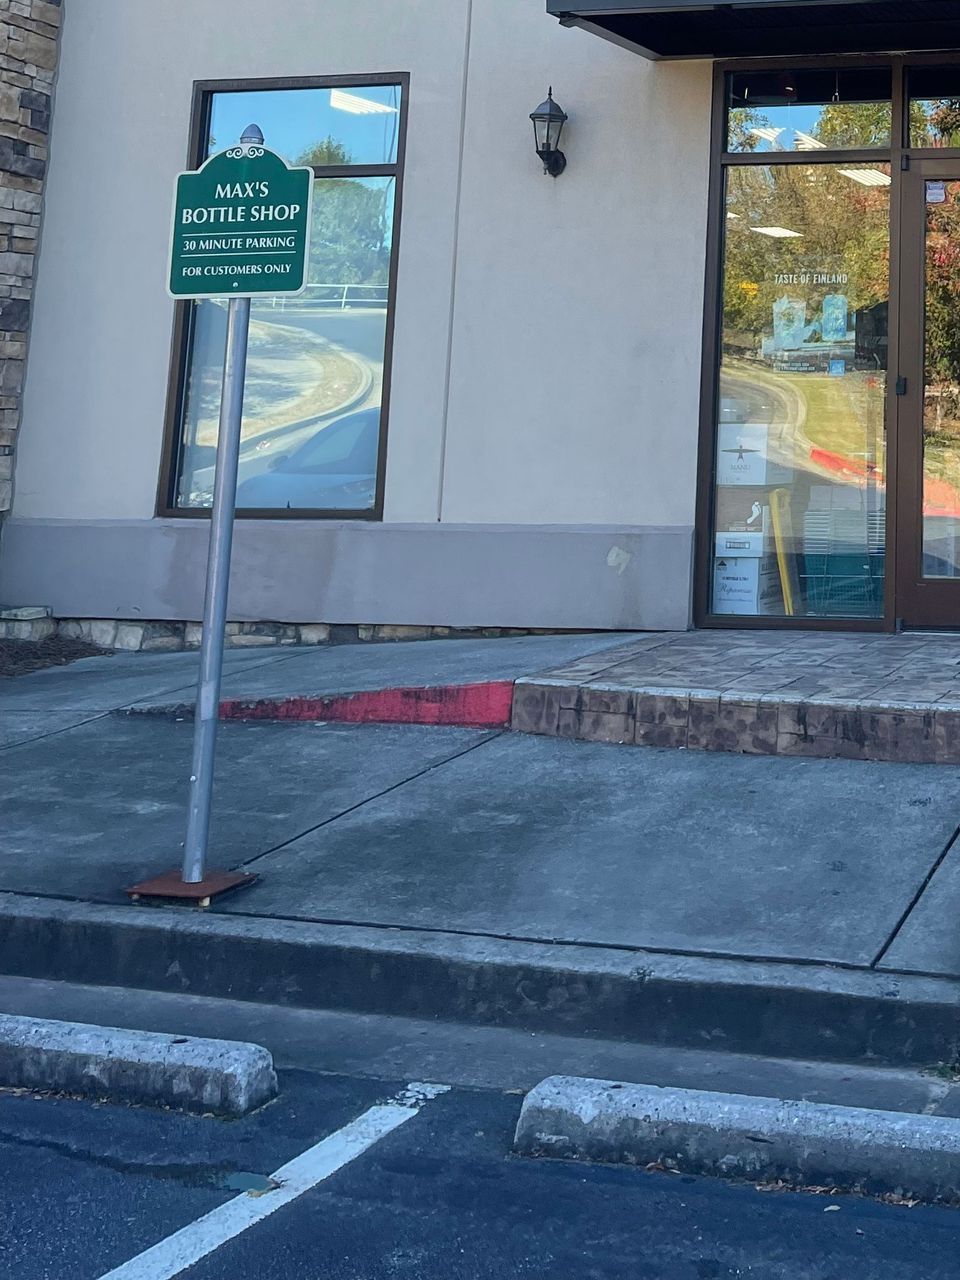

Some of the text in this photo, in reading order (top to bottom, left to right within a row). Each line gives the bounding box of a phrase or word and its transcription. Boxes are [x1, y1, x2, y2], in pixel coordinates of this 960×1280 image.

[215, 182, 269, 199] MAX'S
[182, 204, 300, 224] BOTTLE SHOP
[182, 236, 296, 251] 30 MINUTE PARKING
[182, 263, 292, 277] FOR CUSTOMERS ONLY
[774, 273, 800, 284] TASTE
